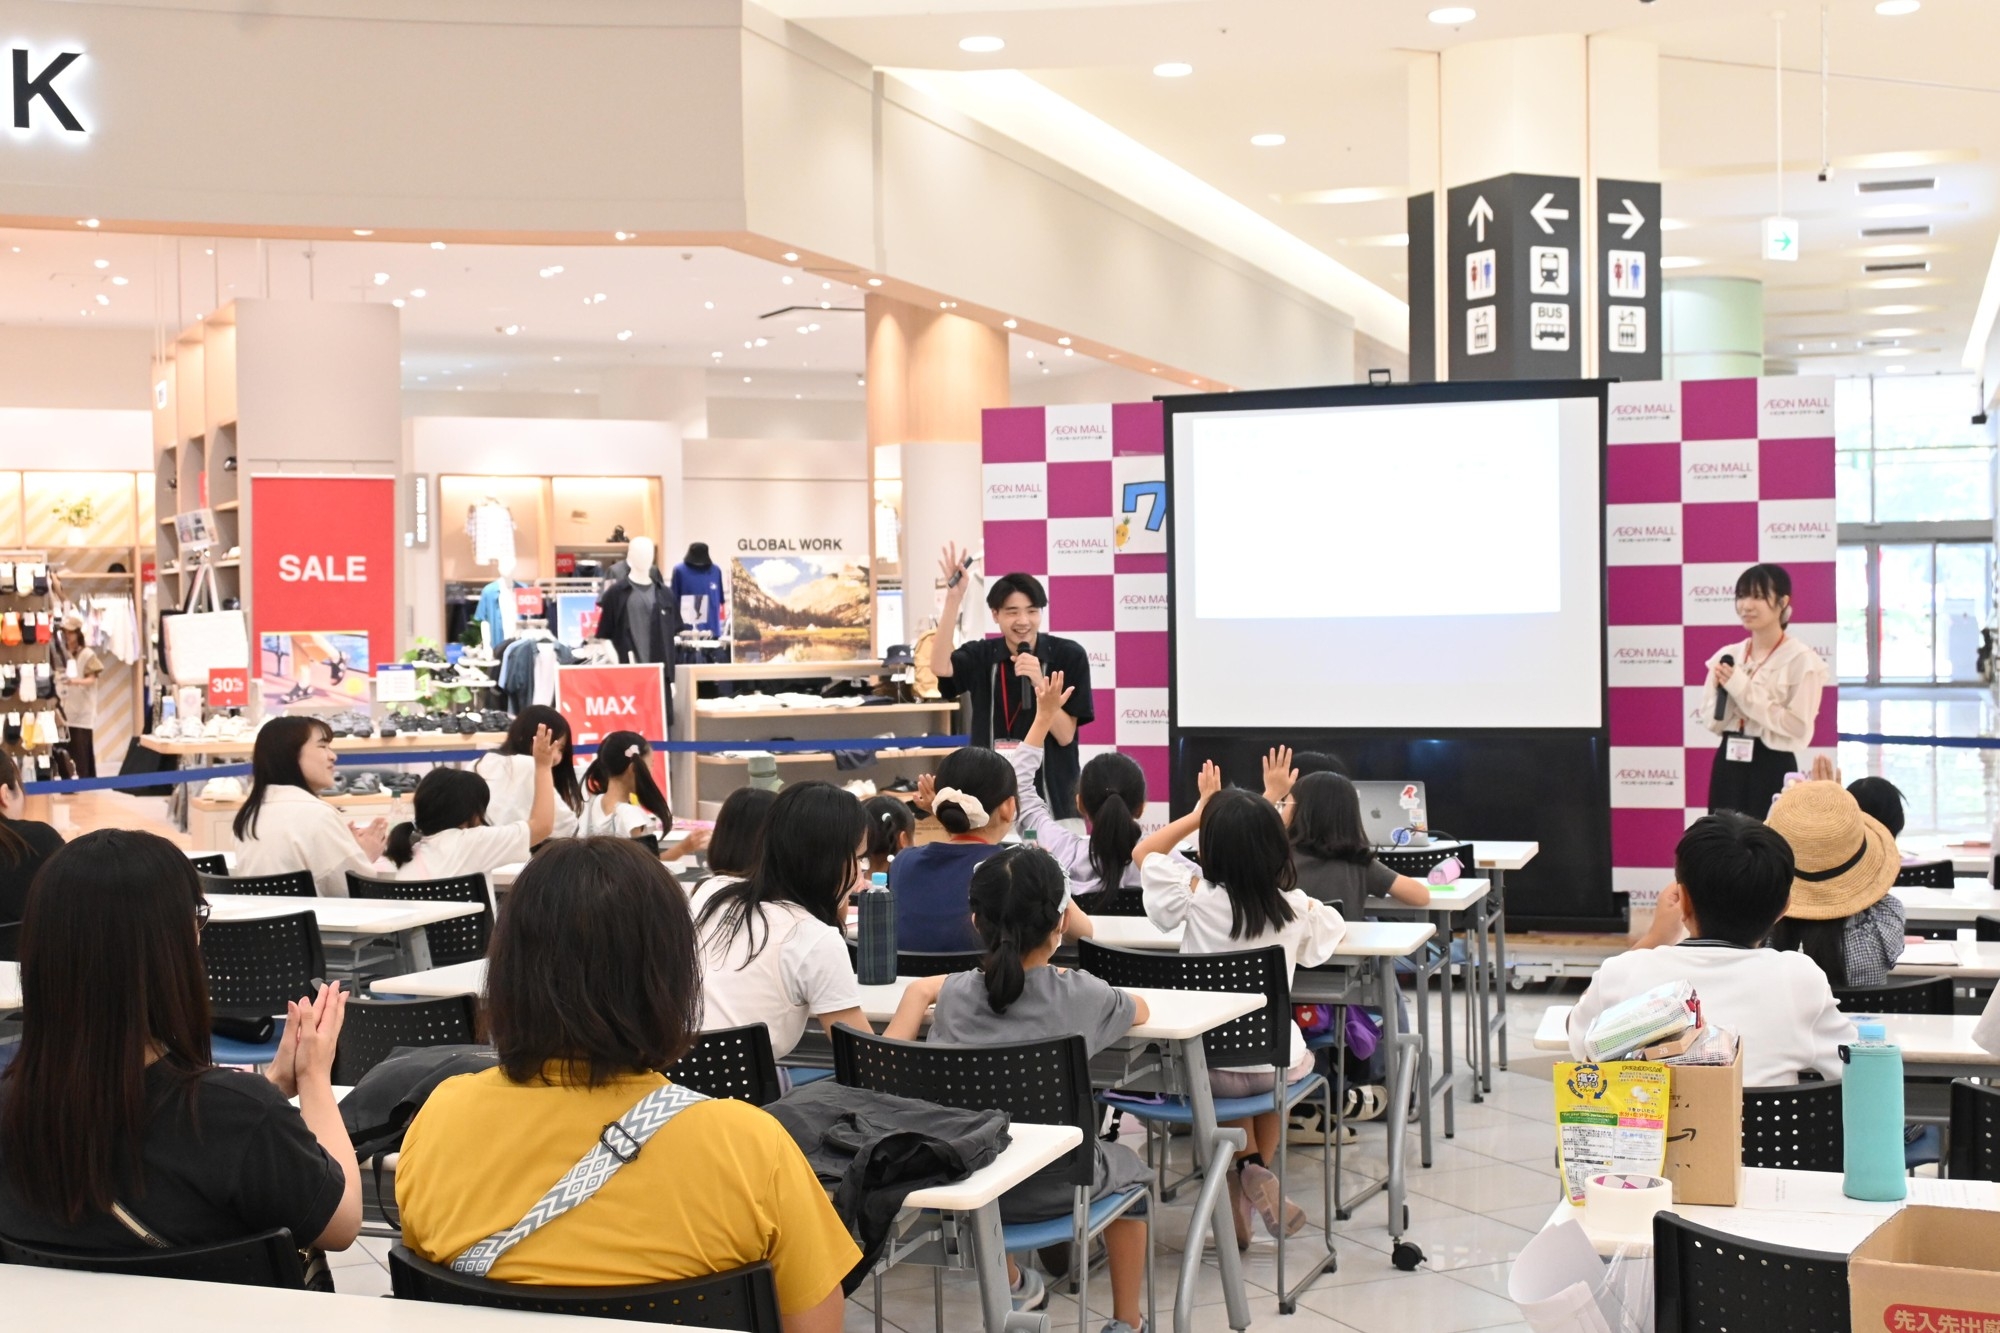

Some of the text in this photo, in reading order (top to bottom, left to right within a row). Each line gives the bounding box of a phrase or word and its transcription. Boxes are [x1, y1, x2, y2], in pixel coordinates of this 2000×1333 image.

[12, 49, 86, 132] K
[1538, 306, 1563, 319] BUS
[1798, 397, 1831, 408] MALL
[1644, 403, 1676, 414] MALL
[1080, 424, 1107, 434] MALL
[1721, 462, 1753, 472] MALL
[1015, 483, 1042, 493] MALL
[1645, 525, 1677, 536] MALL
[1799, 522, 1832, 532] MALL
[737, 538, 843, 551] GLOBAL WORK
[1082, 538, 1109, 548] MALL
[278, 554, 368, 583] SALE
[1149, 594, 1167, 604] MA
[1647, 647, 1678, 658] MALL
[585, 695, 637, 716] MAX
[1151, 709, 1168, 719] MA
[1648, 769, 1680, 779] MALL
